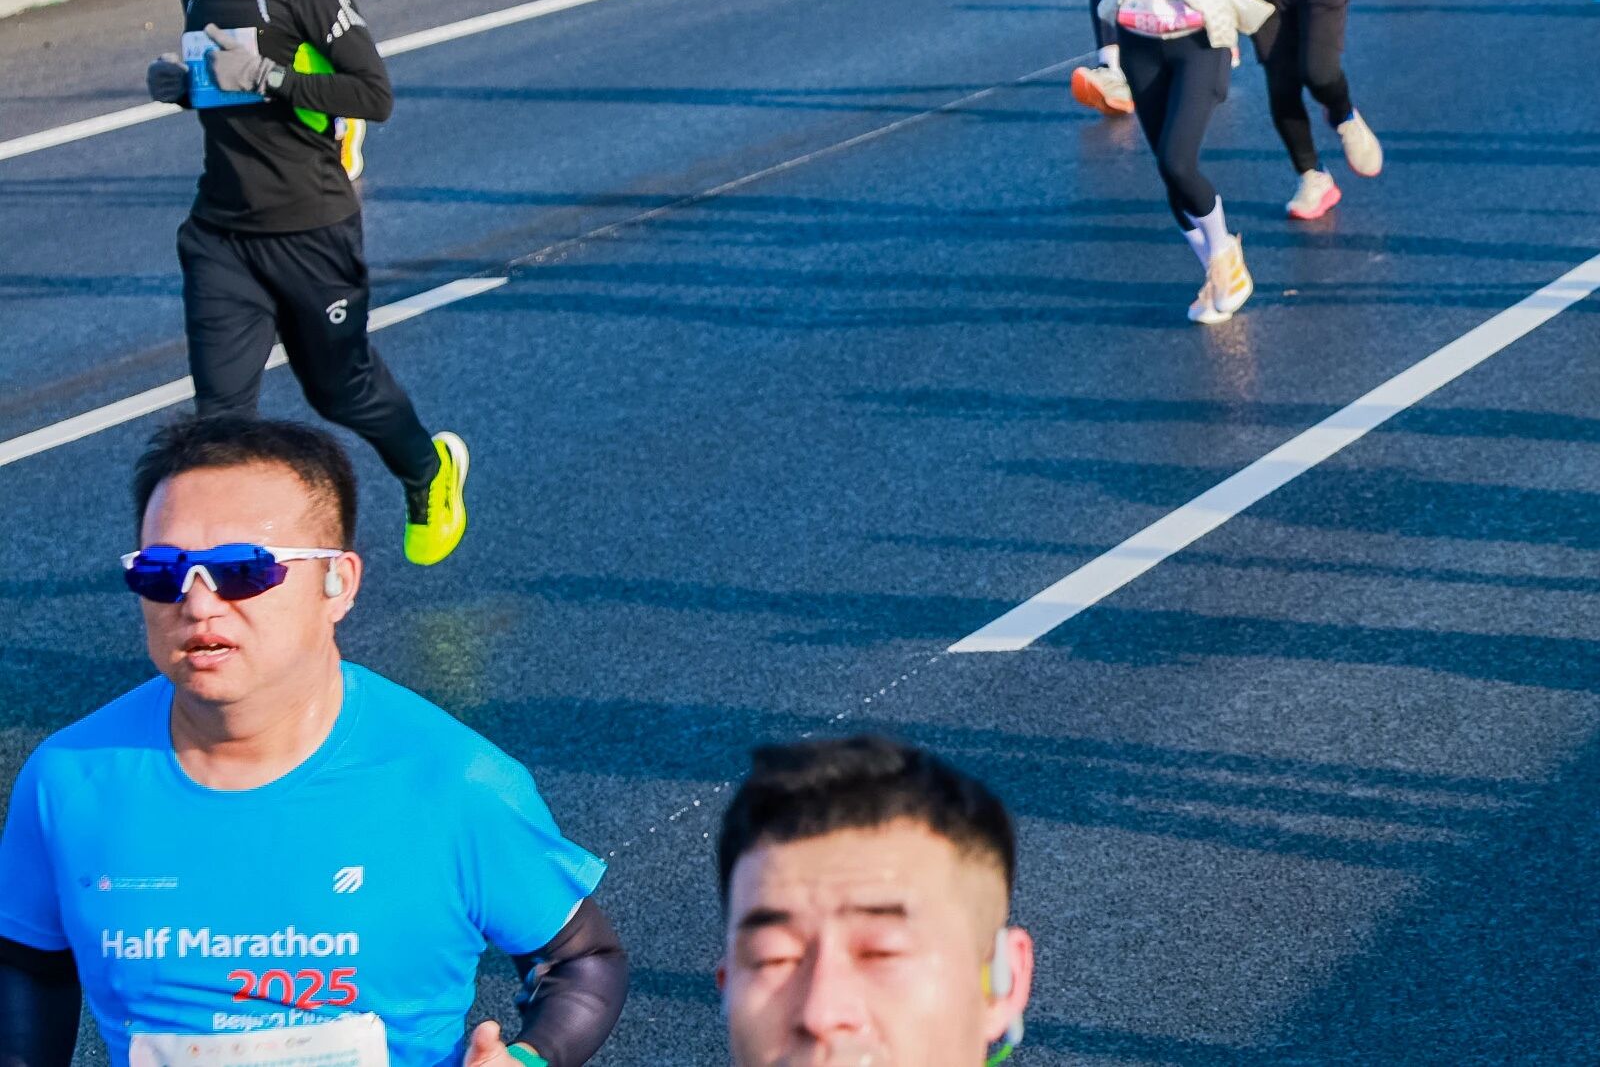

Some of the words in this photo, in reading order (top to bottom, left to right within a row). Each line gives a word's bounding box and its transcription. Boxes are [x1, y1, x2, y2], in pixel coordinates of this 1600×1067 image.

[102, 927, 171, 960] Half
[178, 925, 359, 959] Marathon
[227, 967, 359, 1009] 2025
